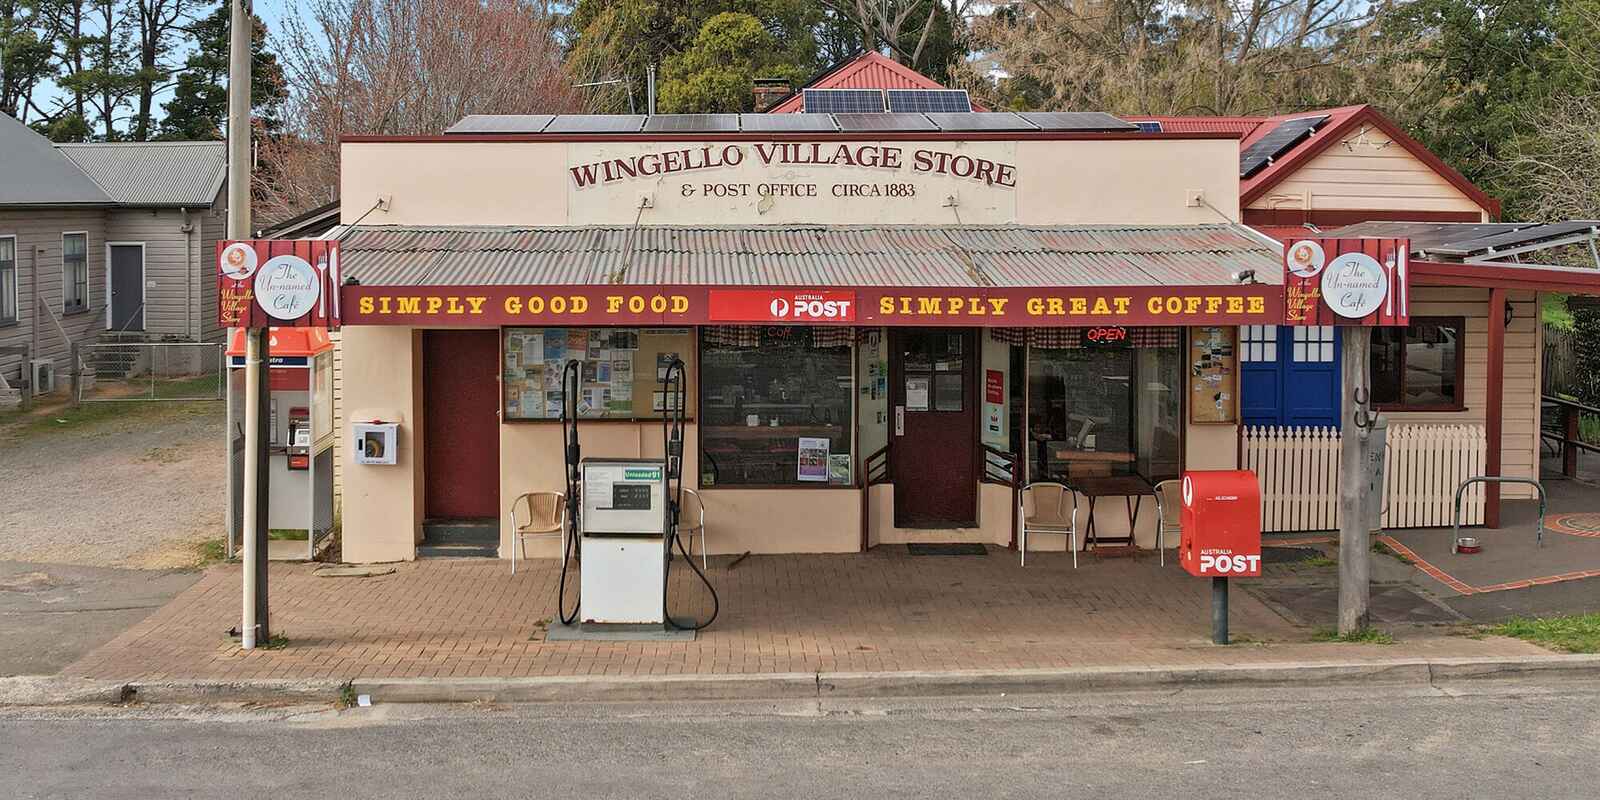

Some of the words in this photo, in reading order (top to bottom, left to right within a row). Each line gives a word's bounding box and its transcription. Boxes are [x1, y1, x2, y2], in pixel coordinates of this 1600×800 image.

[569, 145, 744, 187] WINGELLO
[754, 143, 902, 169] VILLAGE
[913, 149, 1017, 188] STORE
[681, 183, 696, 197] &
[703, 183, 751, 197] POST
[757, 183, 817, 198] OFFICE
[831, 183, 881, 197] CIRCA
[885, 183, 916, 197] 1883
[274, 263, 297, 279] The
[1343, 261, 1365, 277] The
[260, 274, 314, 291] Un-named
[1326, 271, 1380, 289] Un-named
[221, 300, 248, 313] Village
[359, 296, 487, 314] SIMPLY
[504, 296, 588, 314] GOOD
[606, 295, 689, 313] FOOD
[794, 300, 851, 317] POST
[879, 296, 1009, 315] SIMPLY
[1026, 296, 1132, 315] GREAT
[1147, 296, 1265, 314] COFFEE
[1286, 298, 1314, 312] Village
[1087, 328, 1126, 341] OPEN
[1200, 555, 1261, 573] POST
